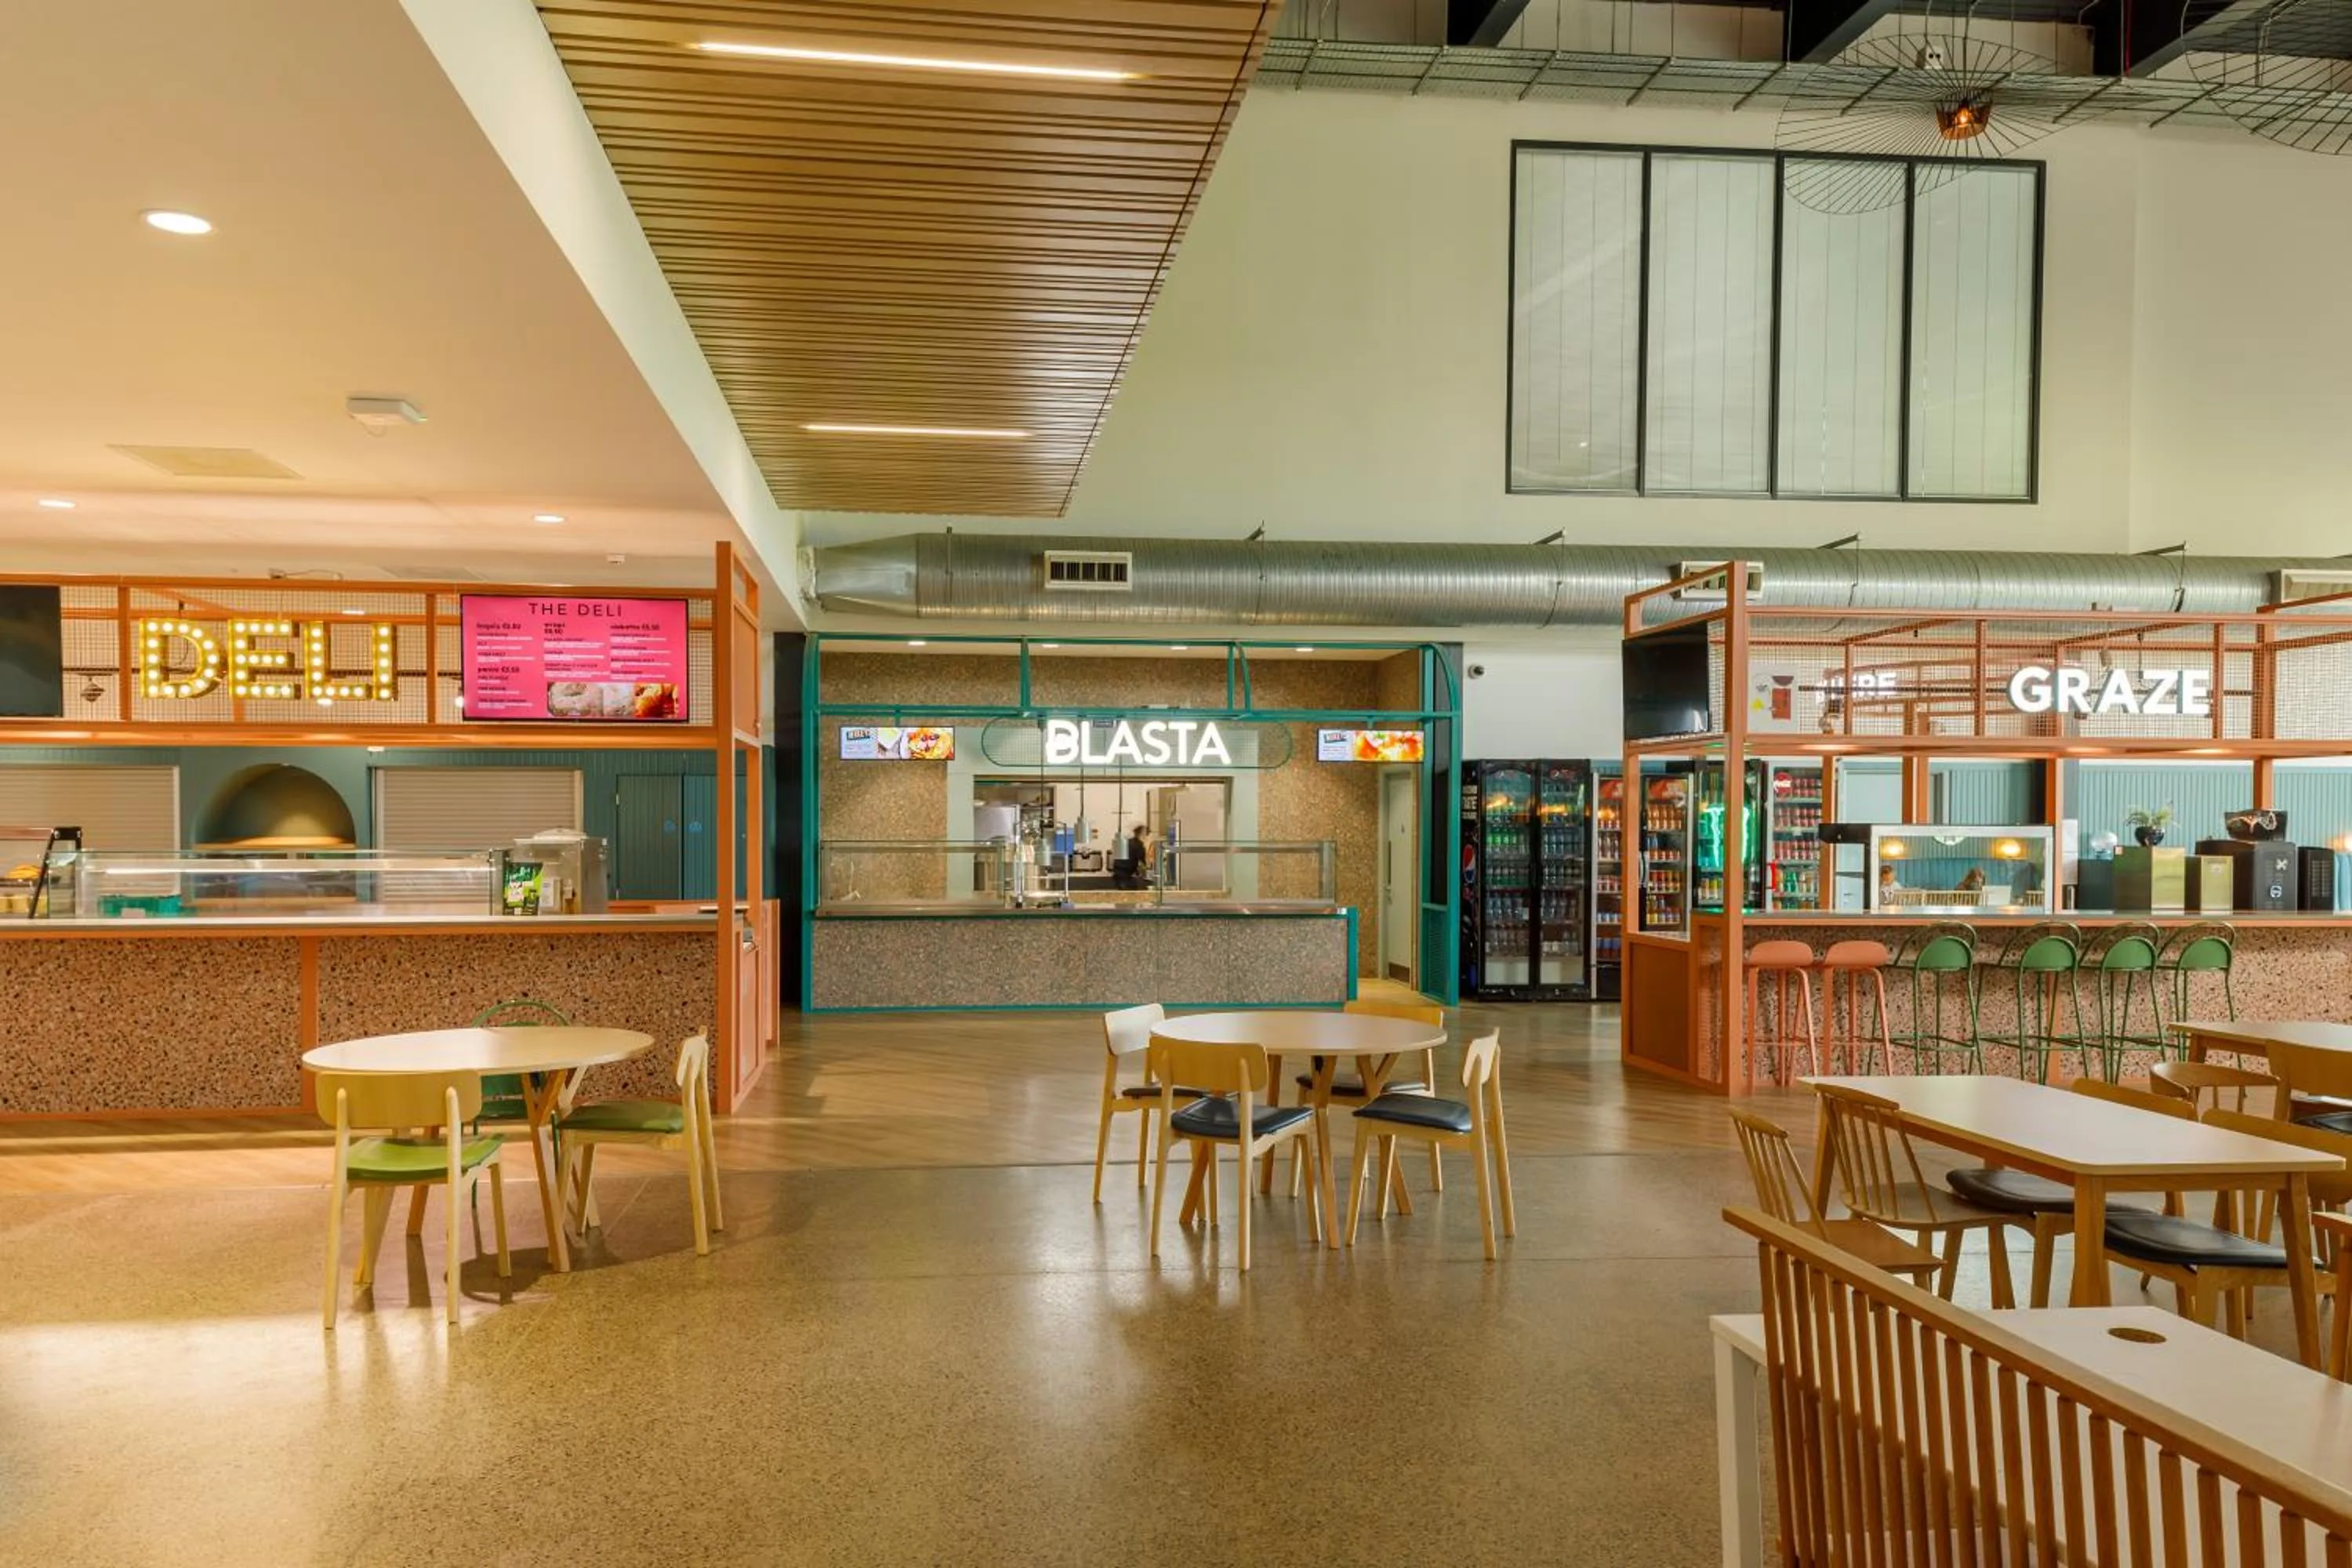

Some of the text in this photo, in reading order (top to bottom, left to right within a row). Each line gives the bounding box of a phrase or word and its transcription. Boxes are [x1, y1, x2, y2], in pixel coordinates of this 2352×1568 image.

[528, 602, 622, 617] THE DELI
[140, 617, 398, 702] DELI
[2008, 665, 2211, 714] GRAZE
[1045, 718, 1232, 765] BLASTA
